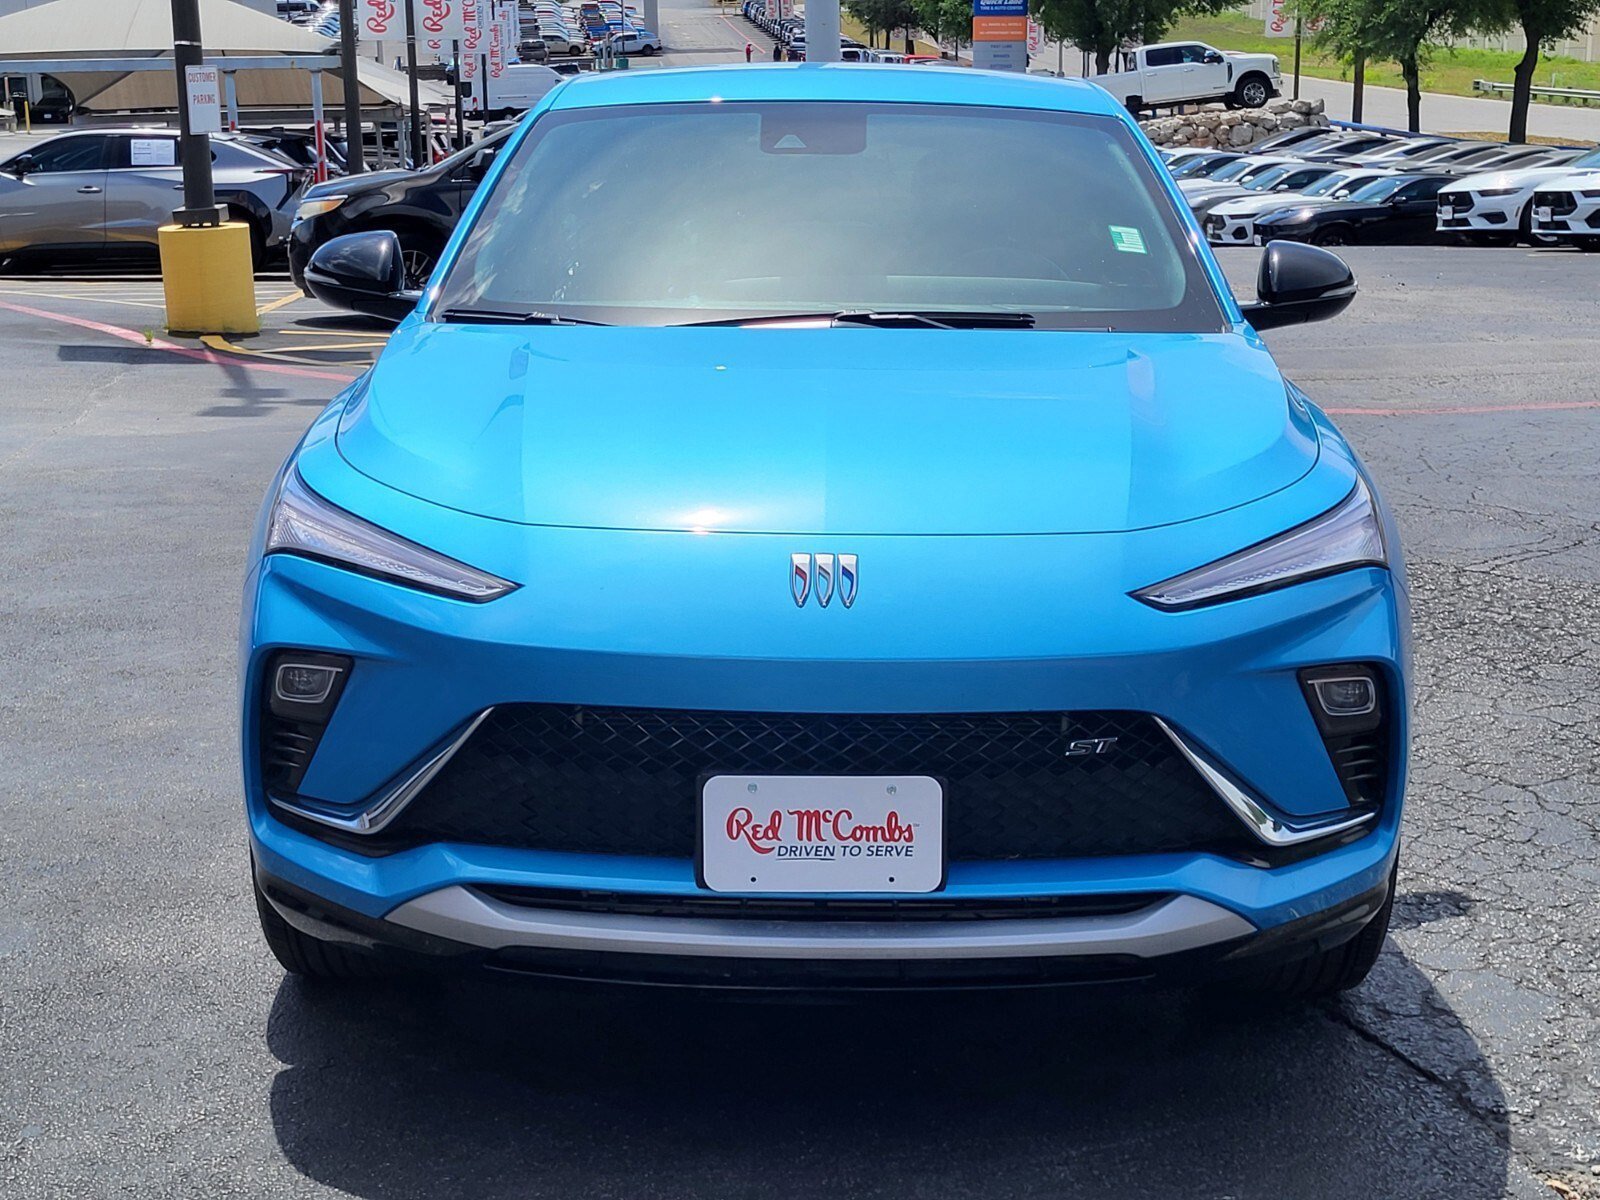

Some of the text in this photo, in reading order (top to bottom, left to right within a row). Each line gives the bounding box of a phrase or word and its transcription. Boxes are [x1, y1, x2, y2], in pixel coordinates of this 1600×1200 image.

[463, 26, 482, 49] Red
[188, 72, 216, 83] CUSTOMER
[490, 62, 504, 78] Red
[193, 94, 215, 104] PARKING
[1065, 737, 1118, 756] ST
[726, 807, 783, 854] Red
[786, 810, 914, 843] McCombs
[777, 845, 914, 857] DRIVEN TO SERVE
